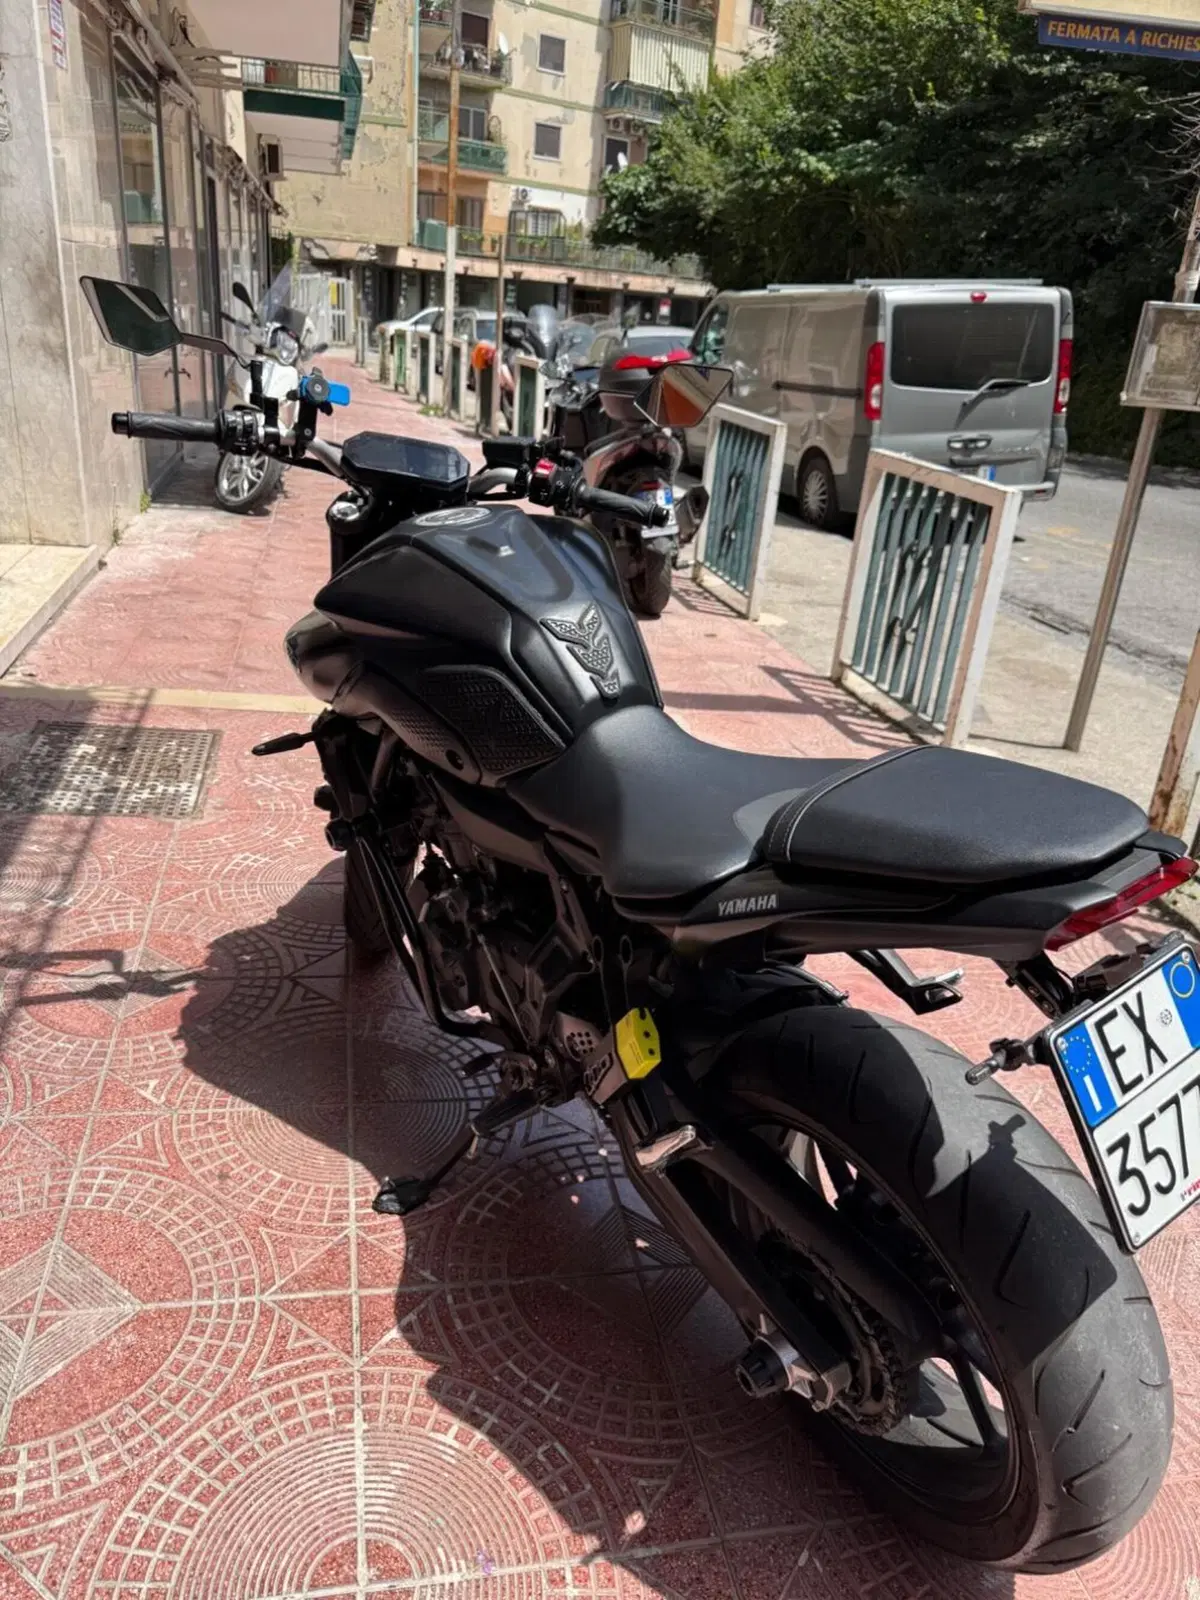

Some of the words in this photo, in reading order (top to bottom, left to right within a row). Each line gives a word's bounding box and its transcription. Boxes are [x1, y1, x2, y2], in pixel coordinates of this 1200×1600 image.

[1047, 20, 1120, 44] FERMATA
[1124, 28, 1137, 46] A
[717, 893, 777, 917] YAMAHA
[1094, 990, 1168, 1096] EX
[1083, 1074, 1103, 1112] I
